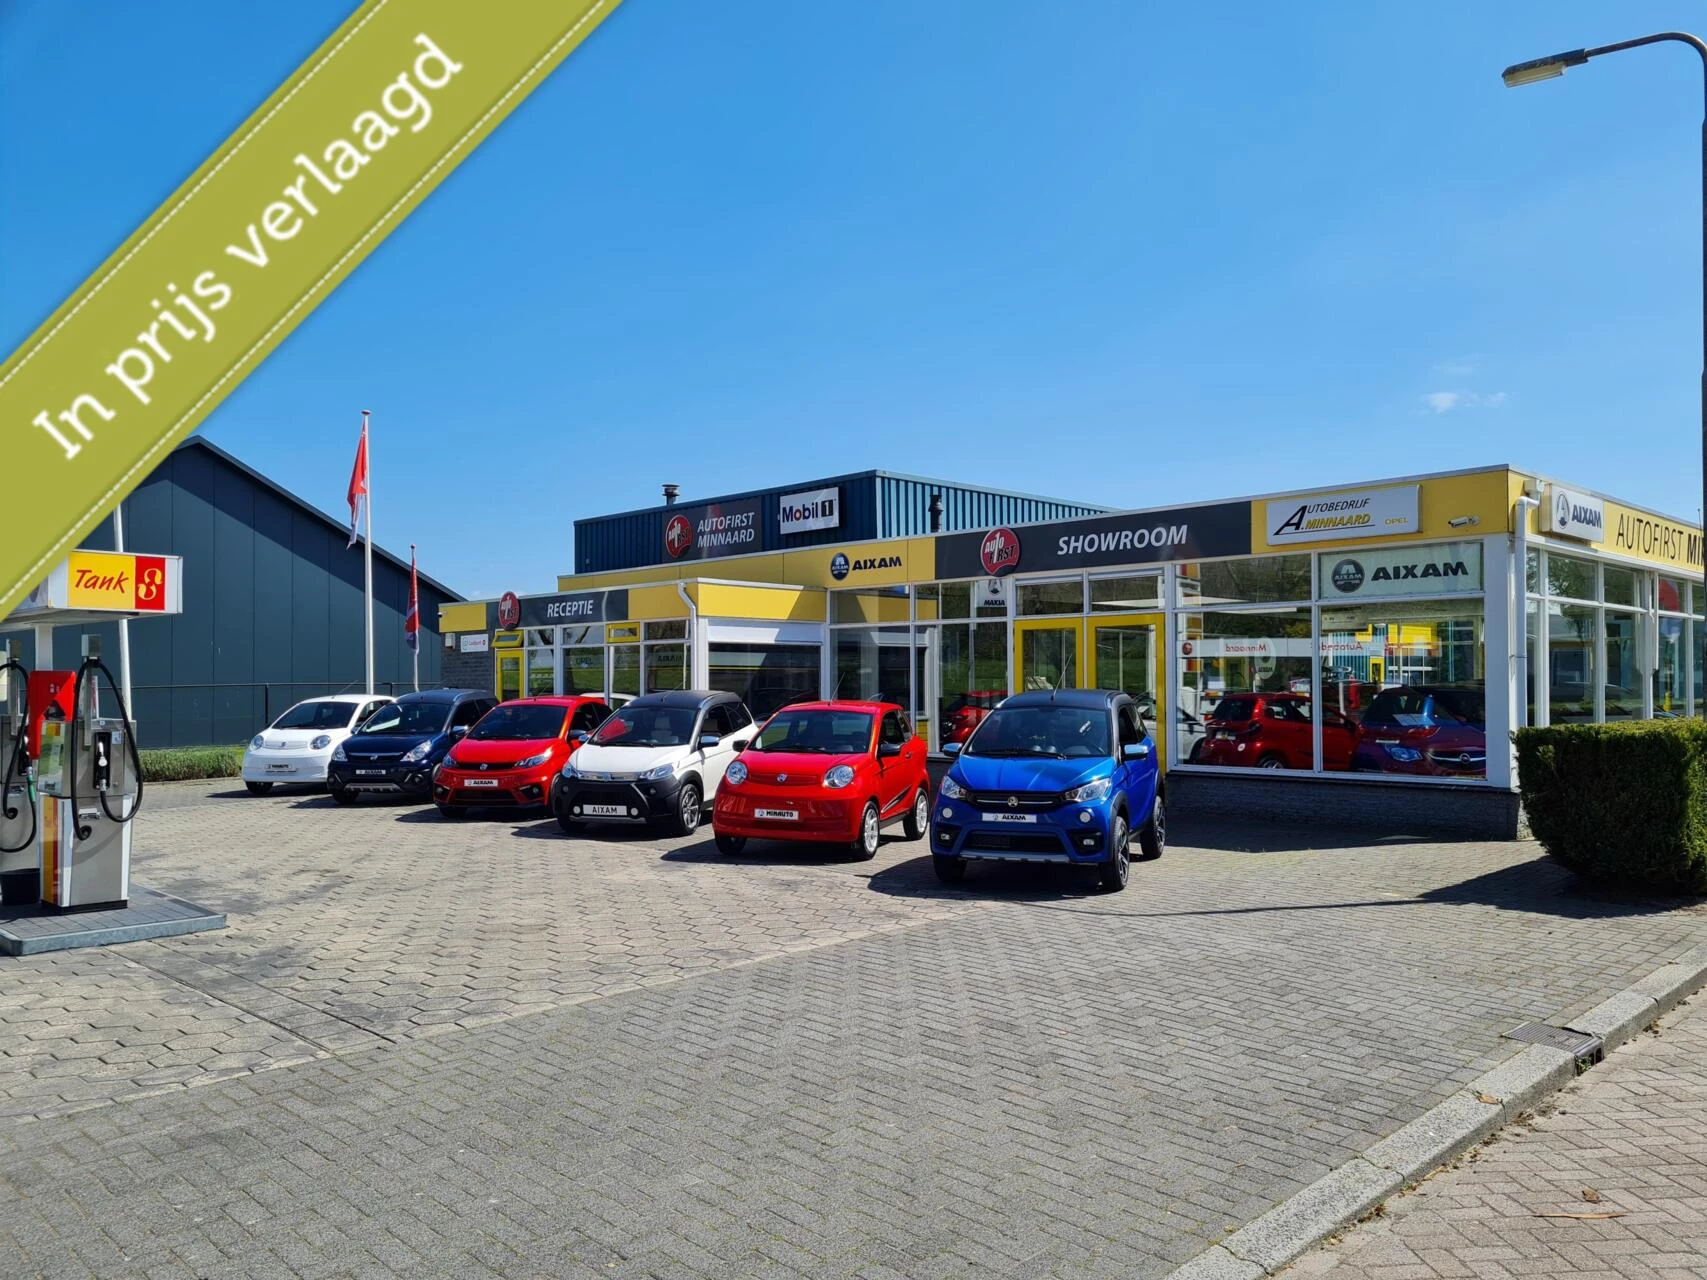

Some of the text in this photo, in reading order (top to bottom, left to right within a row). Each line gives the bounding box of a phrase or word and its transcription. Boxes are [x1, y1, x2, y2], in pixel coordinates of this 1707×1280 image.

[782, 500, 834, 523] Mobil 1
[1571, 504, 1602, 528] AIXAM
[697, 512, 755, 533] AUTOFIRST
[697, 529, 755, 548] MINNAARD
[1057, 524, 1188, 555] SHOWROOM
[1616, 513, 1684, 561] AUTOFIRST
[852, 556, 902, 571] AIXAM
[1371, 561, 1469, 581] AIXAM
[75, 569, 129, 594] Tank
[547, 600, 594, 618] RECEPTIE
[592, 806, 618, 815] AIXAM
[766, 809, 794, 818] MINAUTO
